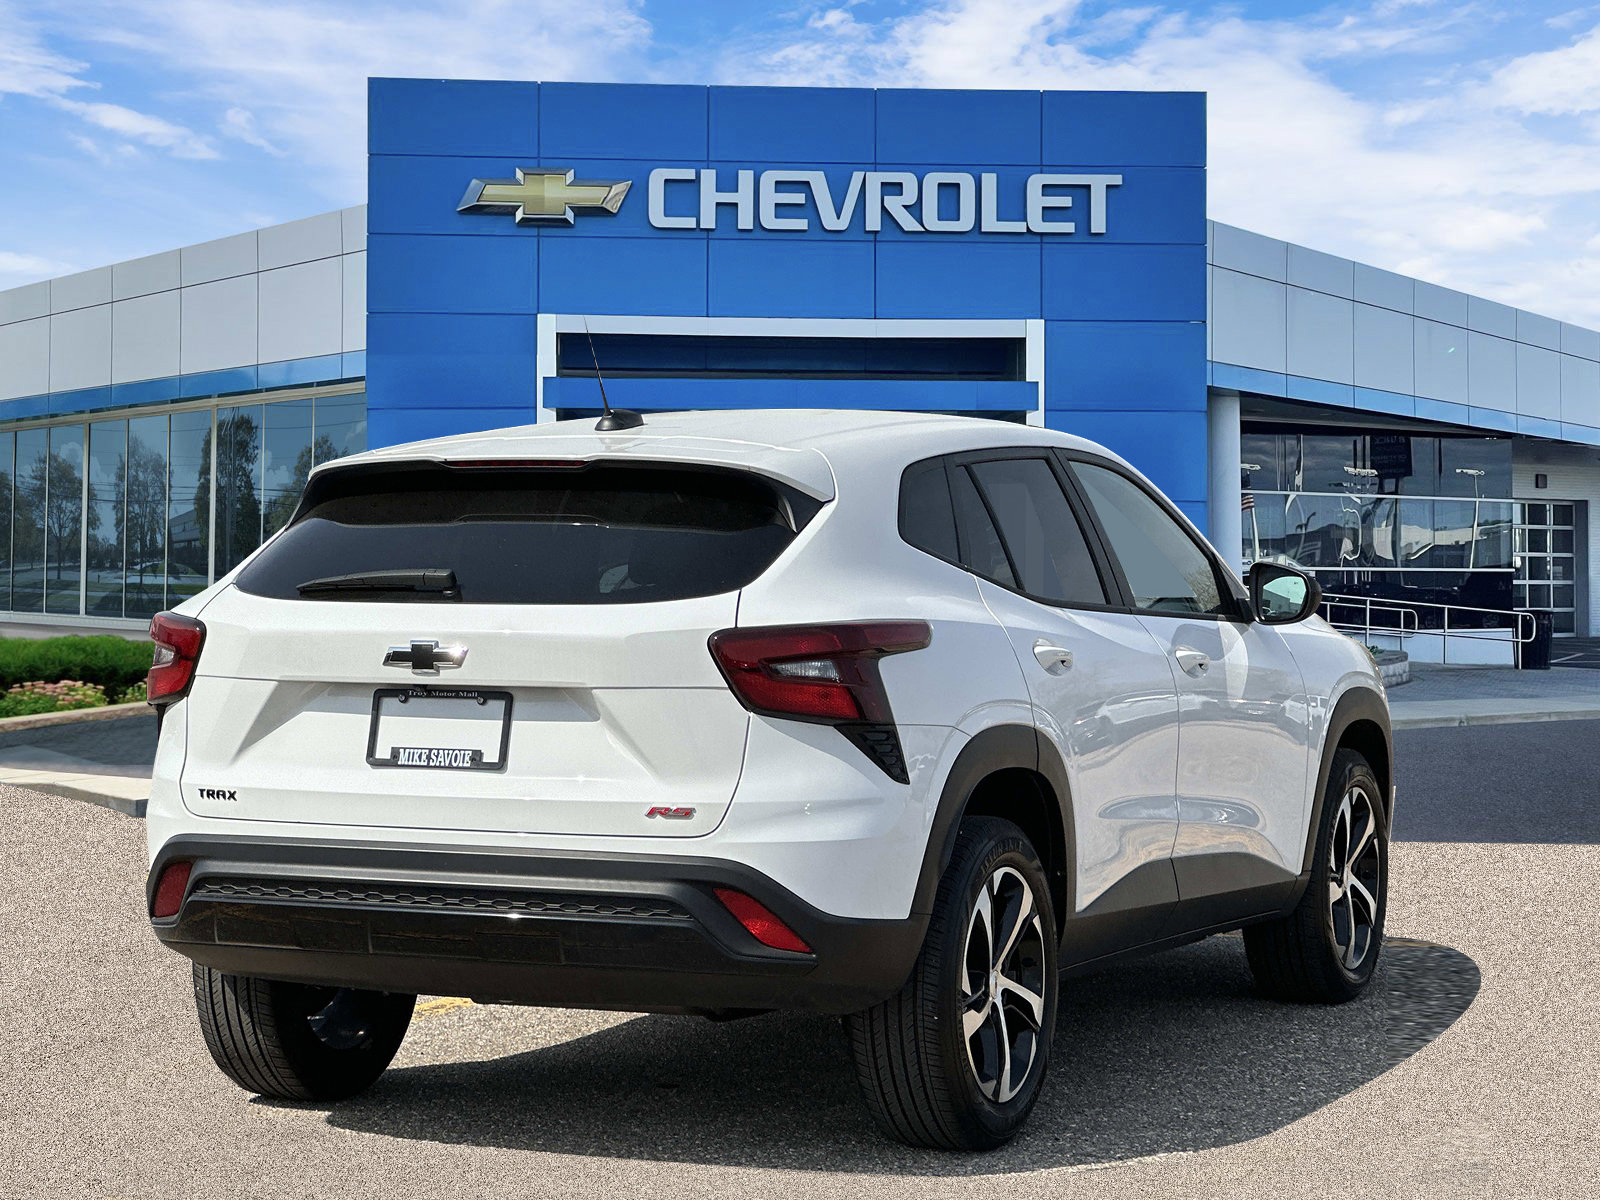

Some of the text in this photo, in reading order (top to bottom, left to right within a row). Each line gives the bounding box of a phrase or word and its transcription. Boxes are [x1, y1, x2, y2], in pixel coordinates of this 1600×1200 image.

[648, 168, 1123, 234] CHEVROLET
[407, 690, 427, 698] Troy
[398, 748, 472, 767] MIKE SAVOIE
[198, 788, 238, 802] TRAX
[645, 806, 696, 820] RS
